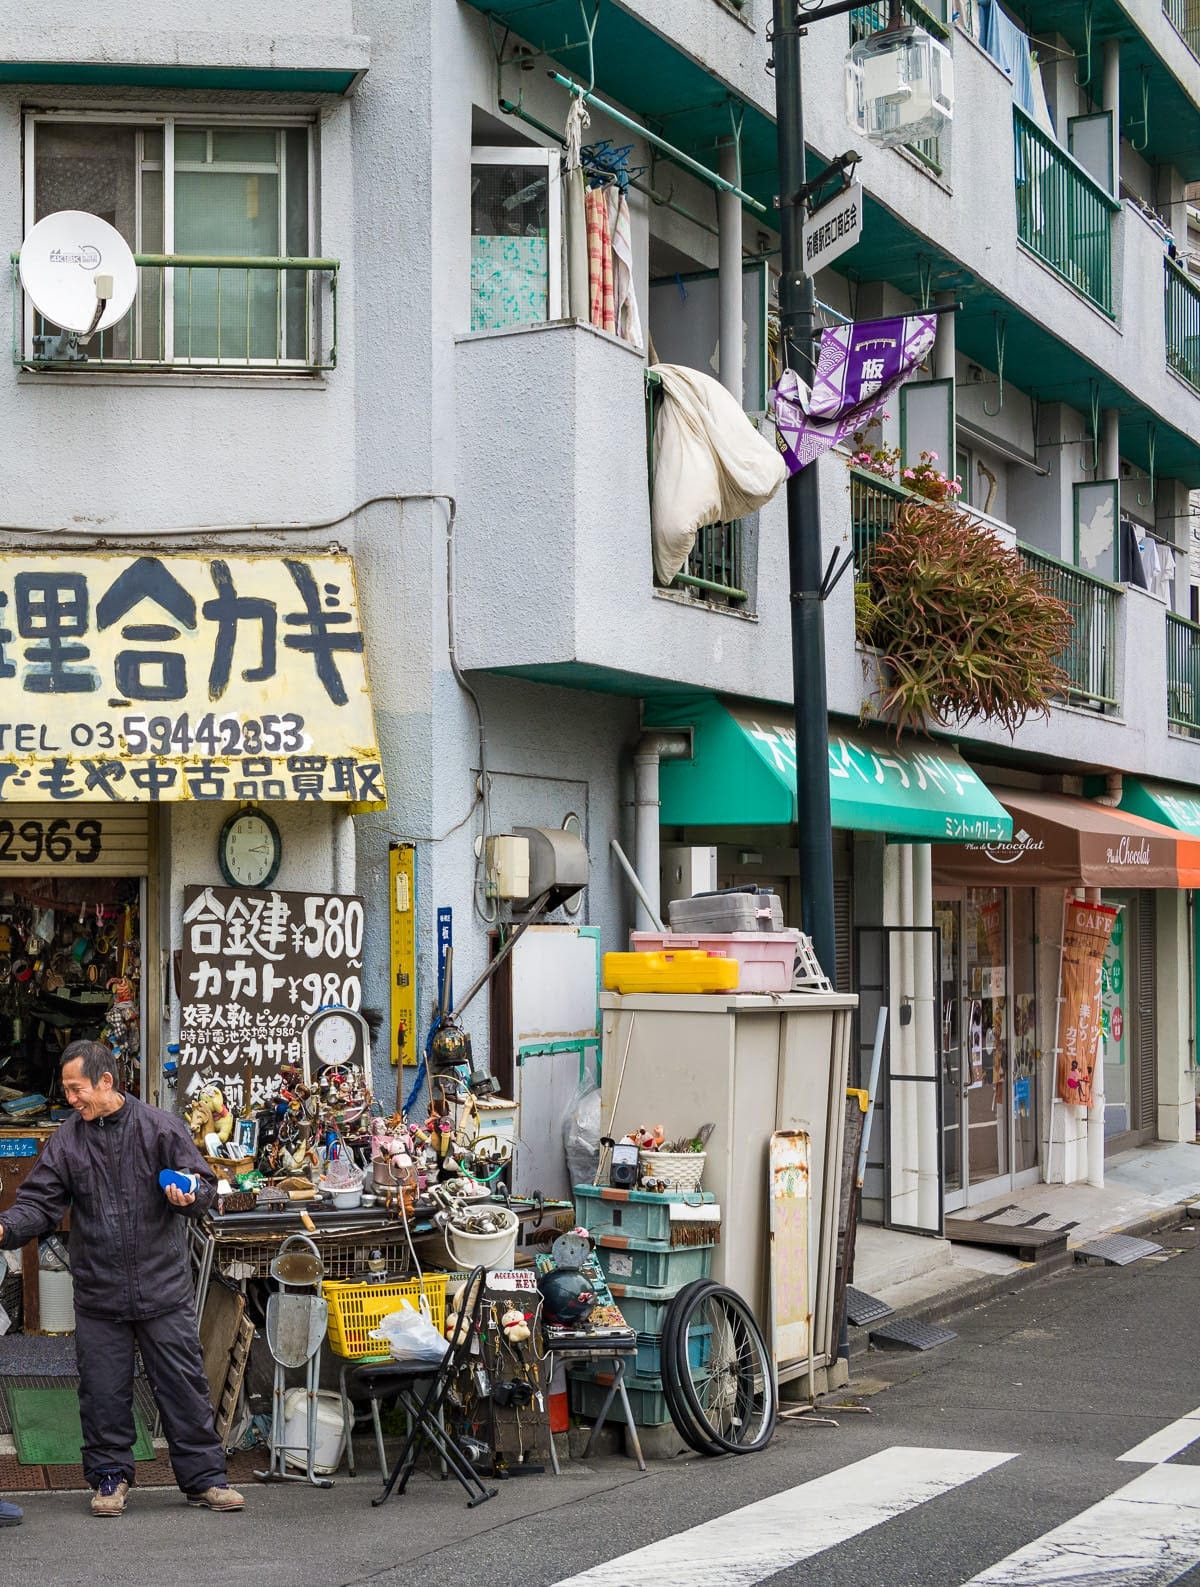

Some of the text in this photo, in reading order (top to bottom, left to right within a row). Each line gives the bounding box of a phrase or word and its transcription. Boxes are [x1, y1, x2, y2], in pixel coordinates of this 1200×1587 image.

[806, 203, 857, 261] 板橋駅西口商店会
[751, 721, 976, 796] 大インランドリー
[945, 816, 1004, 841] ミント・クリーン
[1119, 836, 1151, 865] Chocolat
[183, 887, 291, 961] 合鍵
[1076, 912, 1113, 933] CAFE
[189, 960, 287, 1004] カカト
[515, 1279, 536, 1289] KEY
